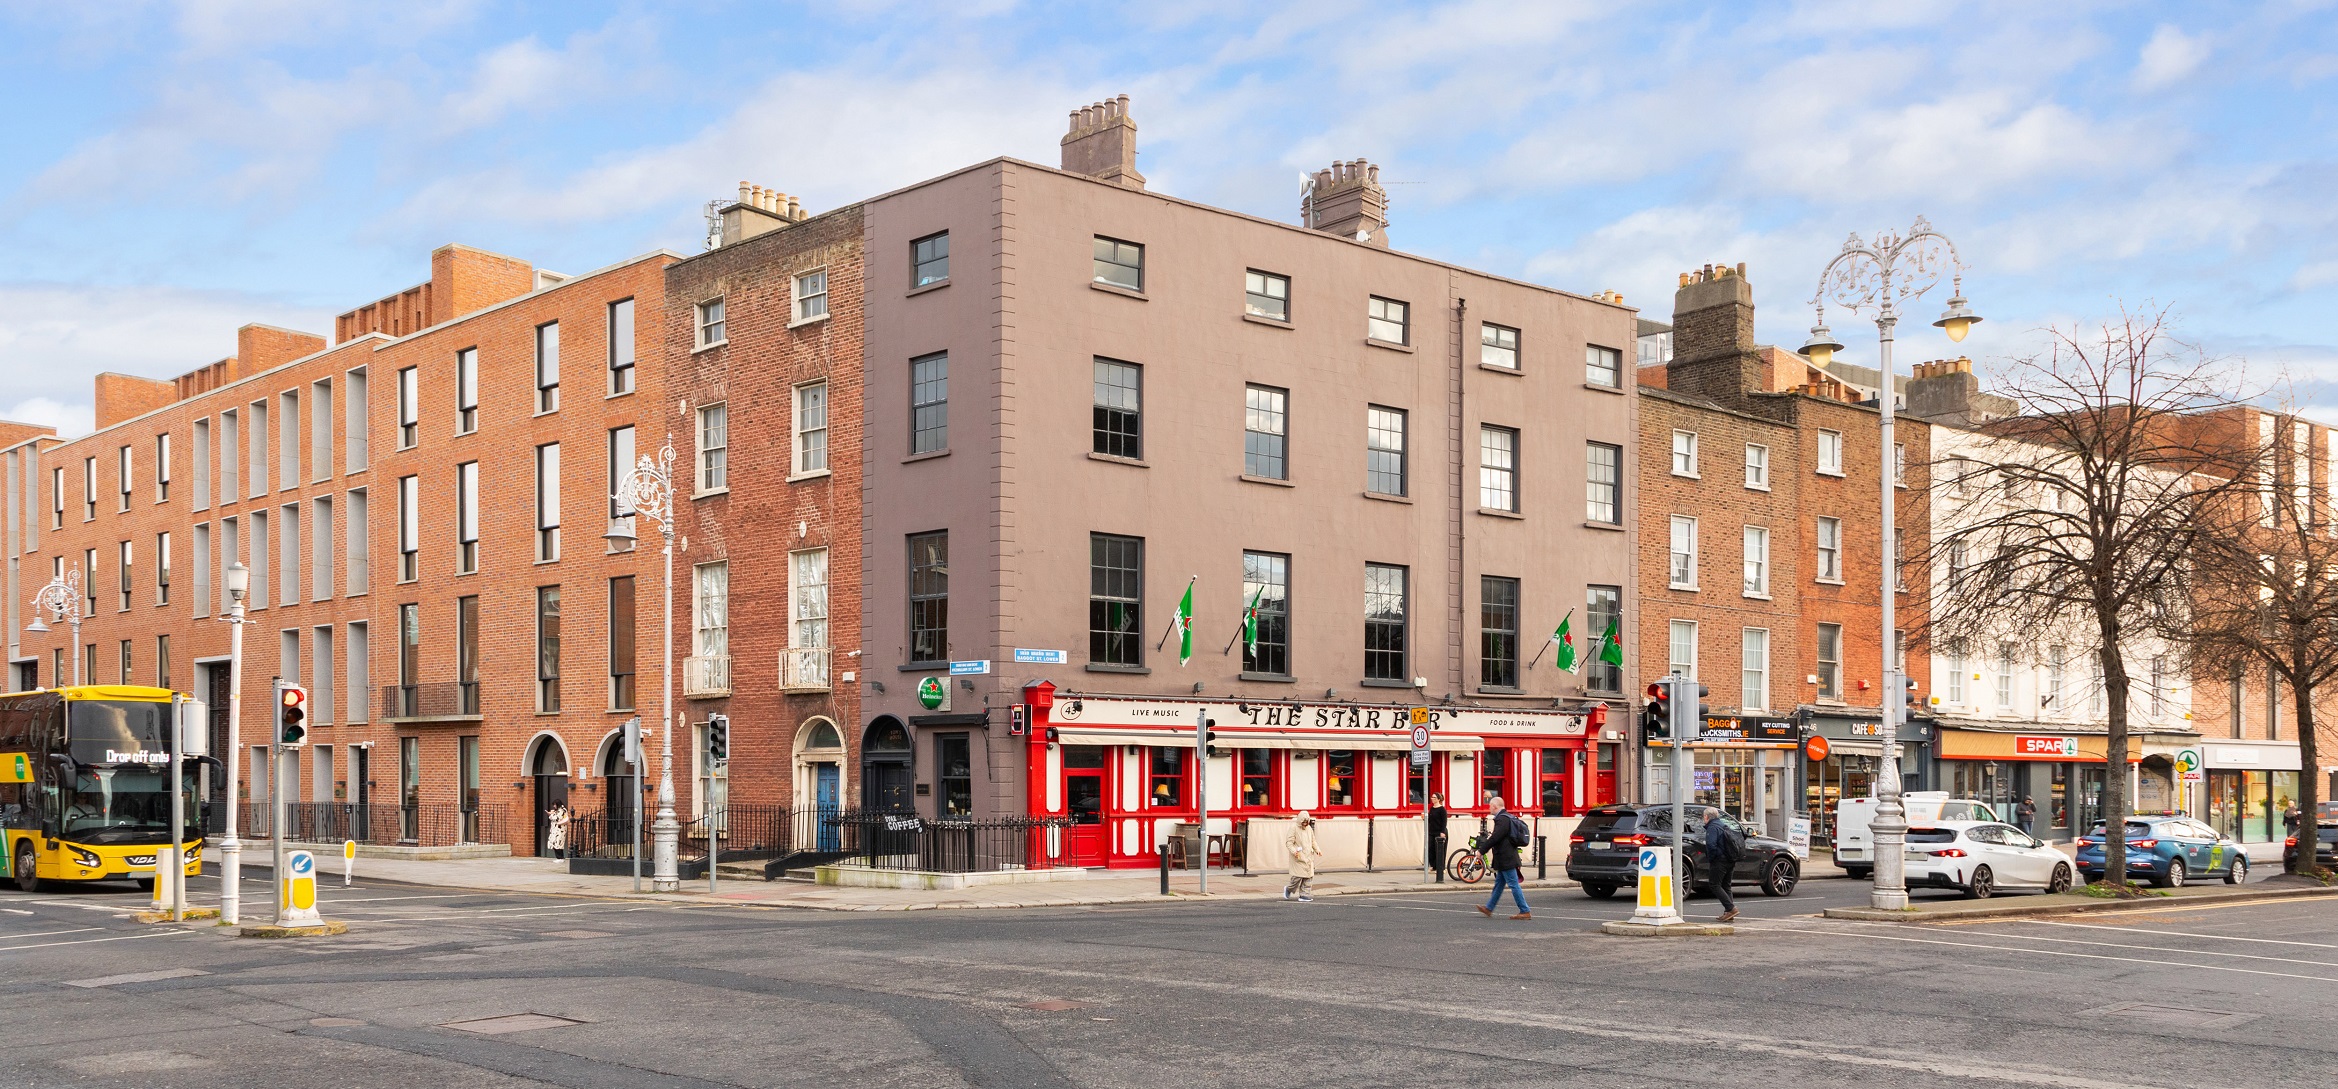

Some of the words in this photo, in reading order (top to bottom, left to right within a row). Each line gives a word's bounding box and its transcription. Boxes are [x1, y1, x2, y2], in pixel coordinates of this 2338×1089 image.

[1065, 706, 1077, 715] 43
[1153, 709, 1179, 717] MUSIC
[1248, 706, 1301, 726] THE
[1314, 708, 1380, 728] STAR
[1391, 711, 1440, 730] BR
[1707, 717, 1742, 729] BAGGOT
[1809, 723, 1817, 732] 46
[1852, 721, 1868, 735] CAFÉ
[1920, 727, 1928, 735] 46
[1416, 731, 1425, 741] 30
[2026, 739, 2062, 752] SPAR
[106, 749, 131, 763] Drop
[132, 750, 149, 763] off
[149, 750, 170, 763] only
[888, 818, 921, 831] COFFEE
[1789, 840, 1807, 848] Repairs
[128, 856, 156, 865] VDL
